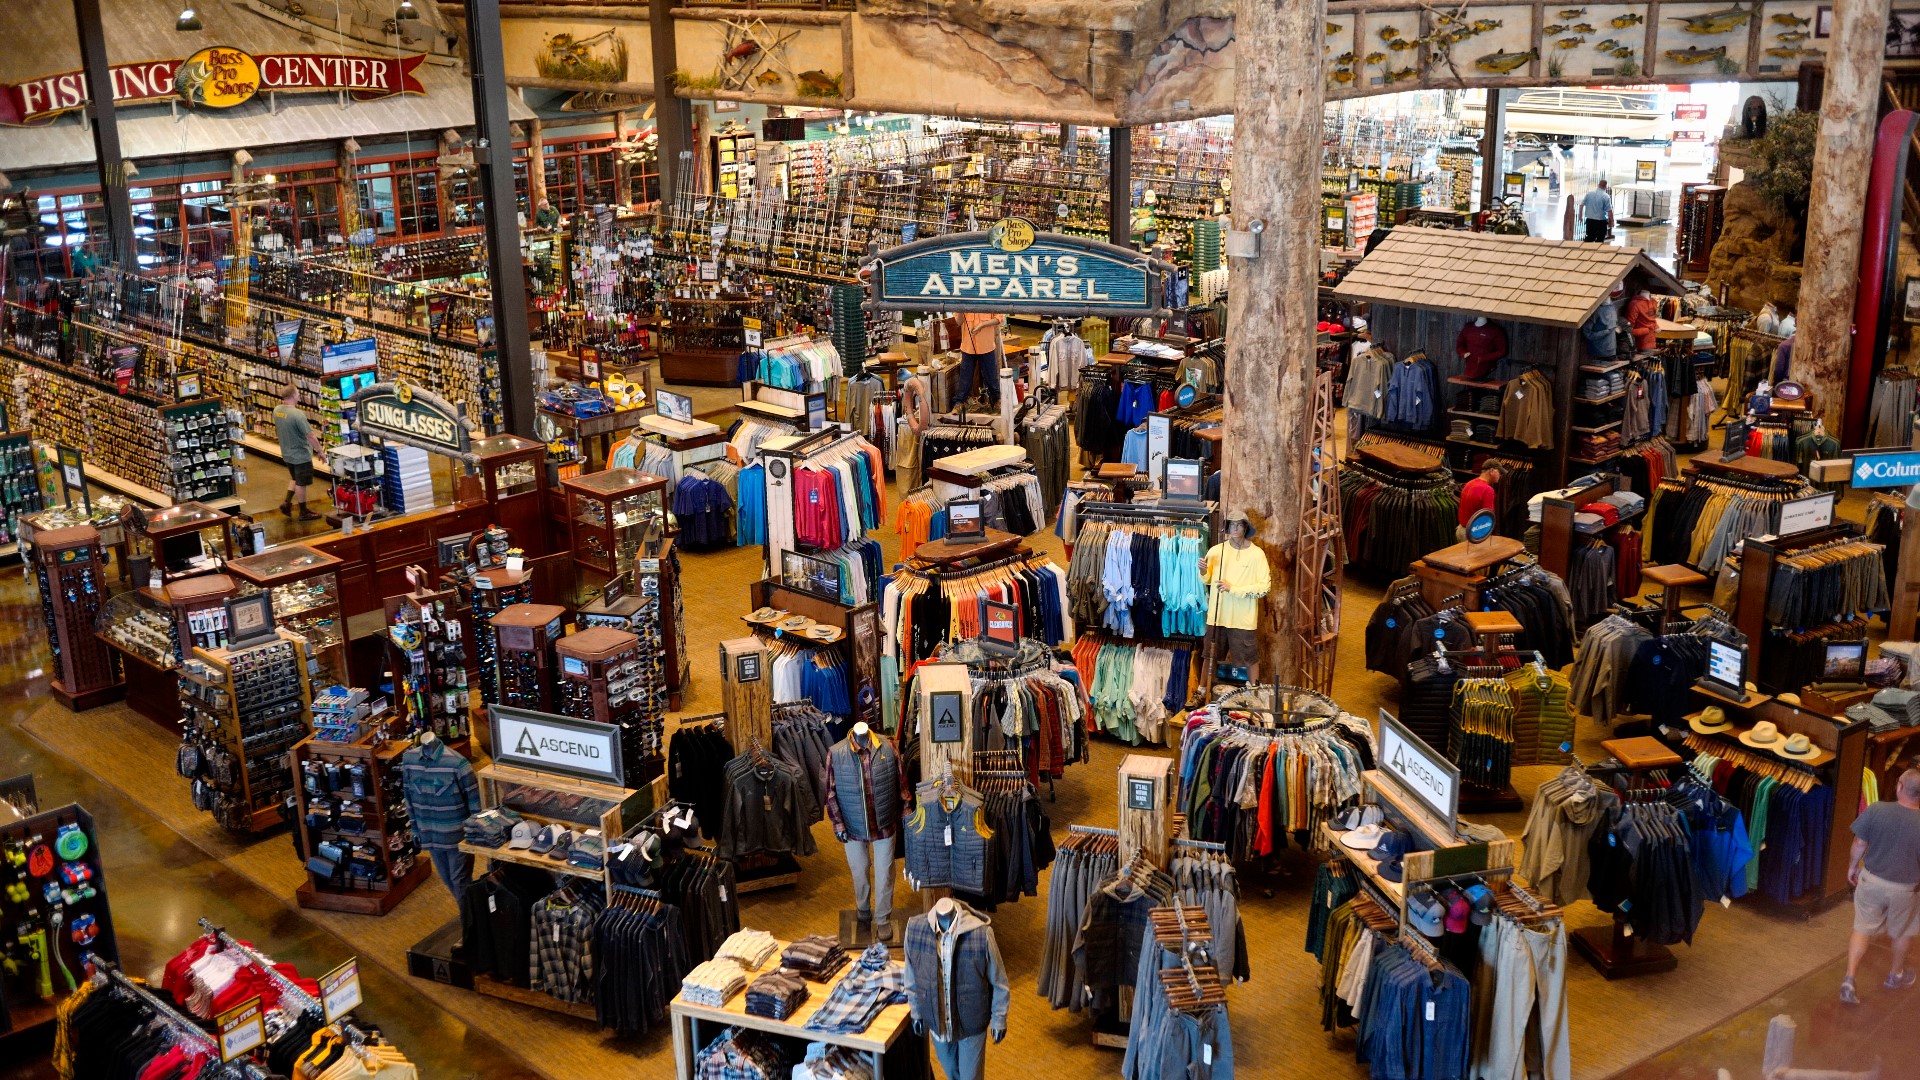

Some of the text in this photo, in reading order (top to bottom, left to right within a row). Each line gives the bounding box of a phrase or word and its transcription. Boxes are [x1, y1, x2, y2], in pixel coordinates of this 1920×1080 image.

[209, 50, 244, 66] Bass
[212, 66, 237, 81] Pro
[260, 57, 389, 88] CENTER
[214, 80, 254, 98] Shops
[1006, 220, 1026, 229] Bass
[1008, 229, 1022, 238] Pro
[1007, 237, 1031, 247] Shops
[950, 251, 1080, 276] MEN'S
[920, 273, 1110, 300] APPAREL
[367, 401, 453, 442] SUNGLASSES
[540, 737, 600, 759] ASCEND
[1407, 758, 1444, 796] ASCEND
[223, 1006, 257, 1032] NEW ITEM
[233, 1029, 260, 1044] Columbia
